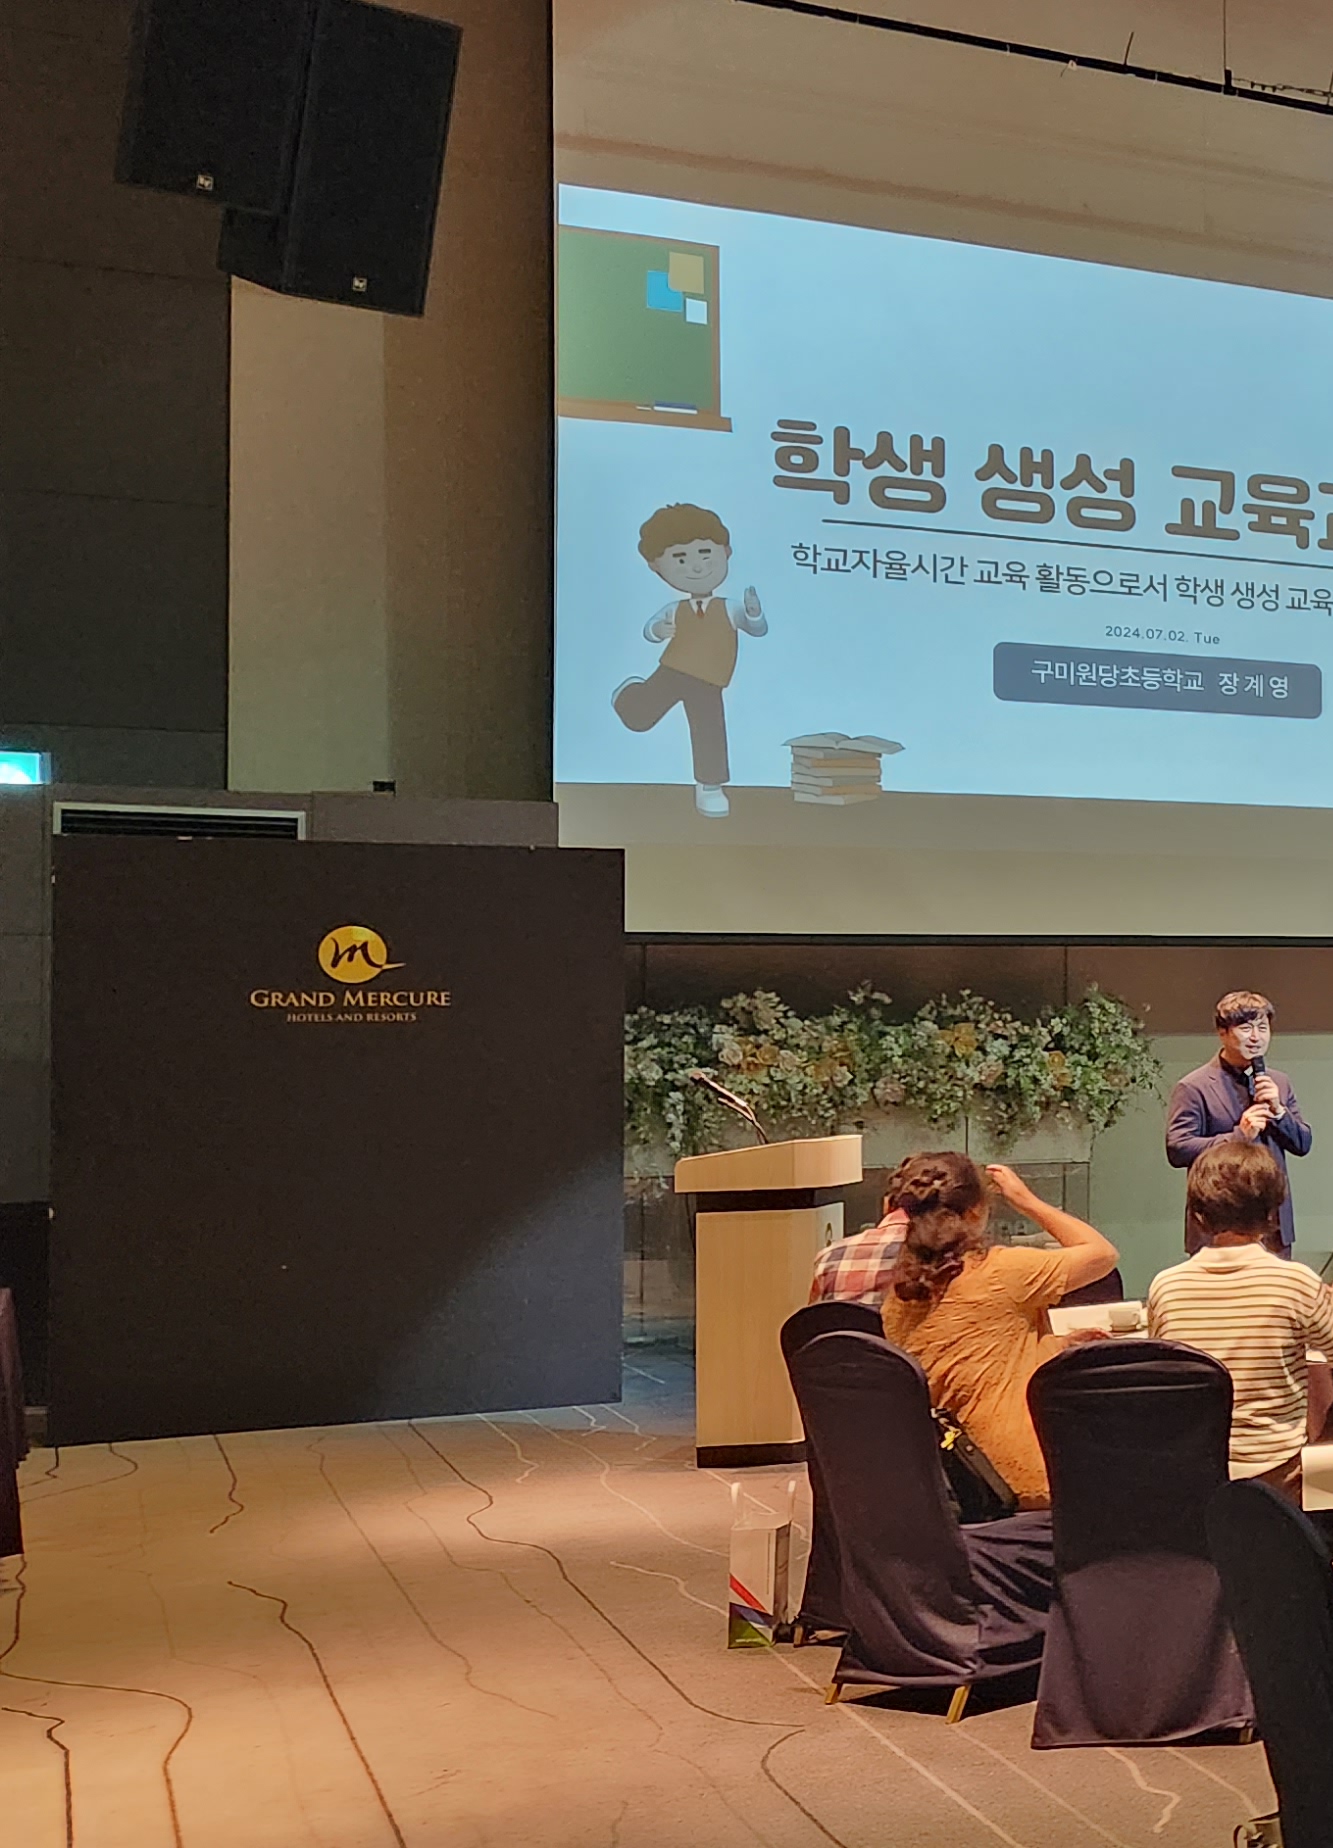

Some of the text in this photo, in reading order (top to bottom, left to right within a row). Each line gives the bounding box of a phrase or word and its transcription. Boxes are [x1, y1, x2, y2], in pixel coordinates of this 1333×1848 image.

[770, 419, 947, 514] 학생
[974, 443, 1137, 532] 생성
[791, 543, 968, 585] 학교자율시간
[973, 559, 1030, 591] 교육
[1035, 562, 1167, 603] 활동으로서
[1174, 575, 1225, 608] 학생
[1230, 581, 1280, 611] 생성
[1193, 632, 1221, 645] Tue
[1031, 660, 1205, 692] 구미원당초등학교
[286, 1012, 417, 1023] HOTELS AND RESORTS
